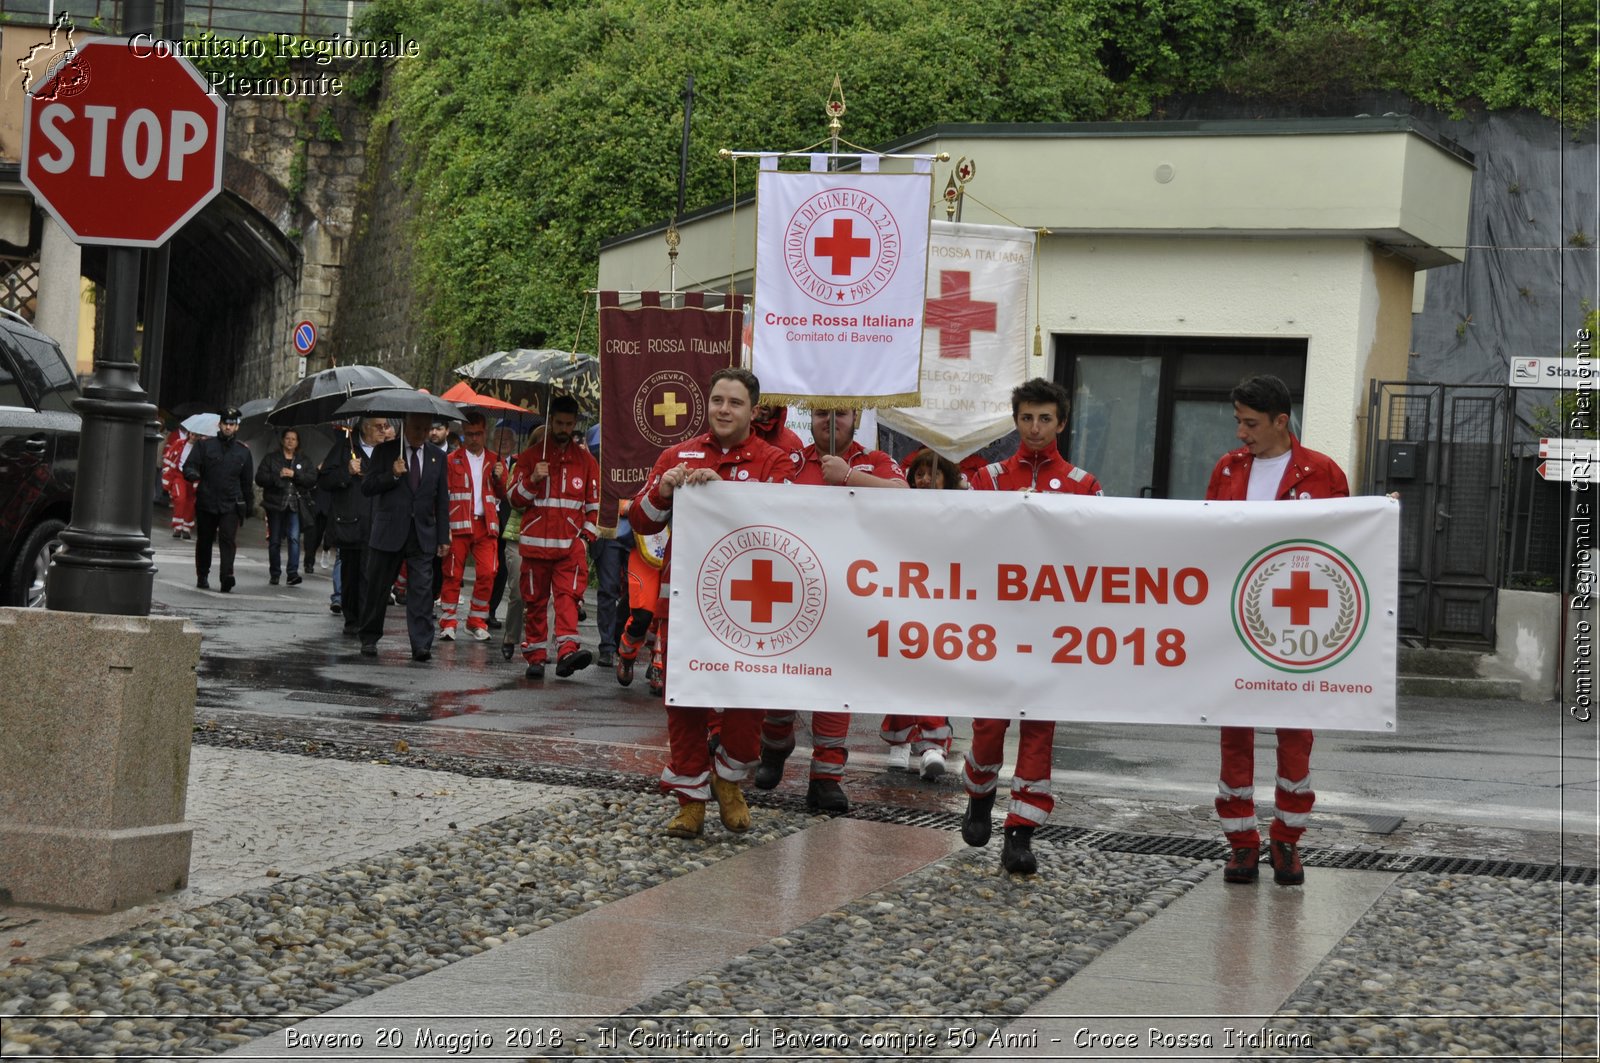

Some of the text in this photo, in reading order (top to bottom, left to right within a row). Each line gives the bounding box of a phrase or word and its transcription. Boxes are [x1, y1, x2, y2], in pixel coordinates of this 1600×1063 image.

[38, 103, 209, 181] STOP
[788, 192, 897, 300] CONVENZIONE DI GINEVRA 22 AGOSTO 1864
[931, 246, 1025, 264] ROSSA ITALIANA
[765, 312, 914, 328] Croce Rossa Italiana
[786, 331, 893, 343] Comitato di Baveno
[605, 338, 732, 355] CROCE ROSSA ITALIANA
[650, 373, 684, 384] GINEVRA
[641, 385, 650, 394] DI
[949, 384, 961, 395] DI
[693, 392, 703, 426] AGOSTO
[636, 397, 662, 444] CONVENZIONE
[1291, 554, 1310, 562] 1968
[1291, 561, 1310, 569] 2018
[702, 531, 822, 650] CONVENZIONE DI GINEVRA 22 AGOSTO 1864
[846, 559, 1209, 606] C.R.I. BAVENO
[866, 619, 1187, 667] 1968 - 2018
[1279, 629, 1319, 657] 50
[688, 659, 832, 677] Croce Rossa Italiana
[1234, 678, 1373, 694] Comitato di Baveno
